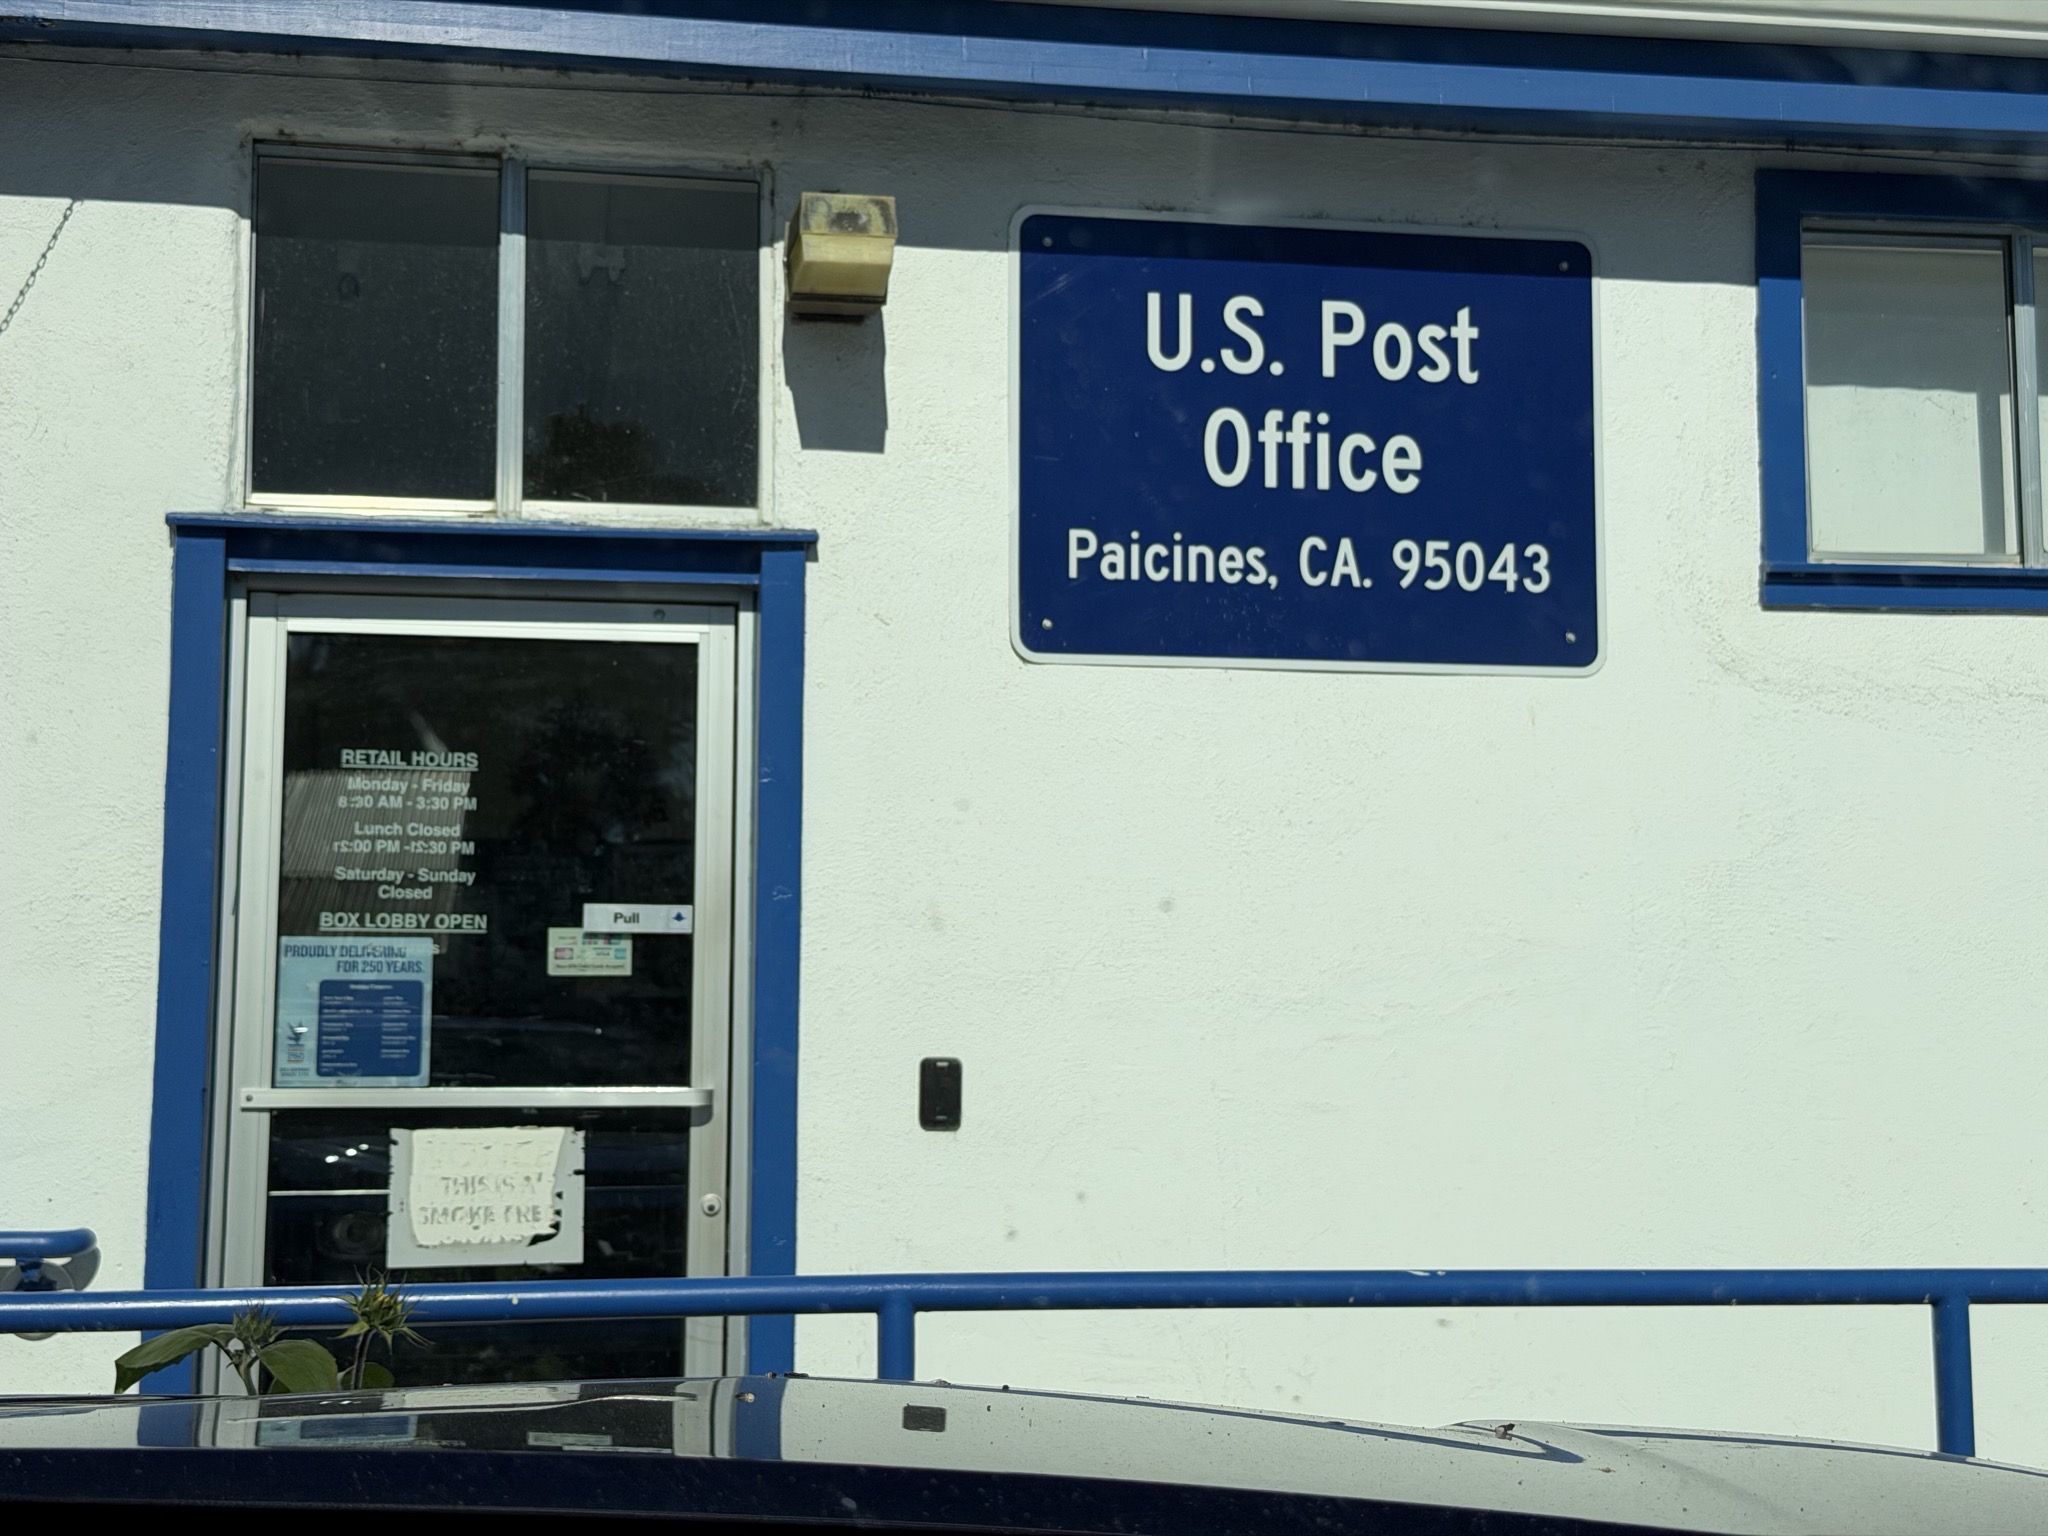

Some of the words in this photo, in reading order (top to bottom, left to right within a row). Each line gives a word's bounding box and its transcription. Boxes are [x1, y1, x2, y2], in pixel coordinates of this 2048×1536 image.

[1147, 292, 1284, 375] U.S.
[1321, 300, 1479, 384] Post
[1204, 407, 1422, 494] Office
[1068, 528, 1278, 590] Paicines,
[1299, 536, 1372, 588] CA.
[1392, 540, 1551, 593] 95043
[341, 749, 407, 767] RETAIL
[411, 751, 479, 768] HOURS
[347, 776, 408, 794] Monday
[422, 778, 471, 796] Friday
[377, 796, 403, 809] AM
[416, 797, 449, 810] 3:30
[453, 797, 477, 811] PM
[354, 821, 403, 836] Lunch
[406, 823, 461, 837] Closed
[375, 840, 400, 853] PM
[450, 841, 475, 855] PM
[334, 865, 405, 884] Saturday
[417, 867, 476, 886] Sunday
[378, 884, 433, 899] Closed
[319, 911, 360, 928] BOX
[364, 912, 430, 929] LOBBY
[434, 913, 488, 930] OPEN
[613, 911, 640, 924] Pull
[283, 943, 336, 958] PROUDLY
[336, 960, 360, 973] FOR
[361, 960, 384, 973] 250
[386, 960, 425, 974] YEARS.
